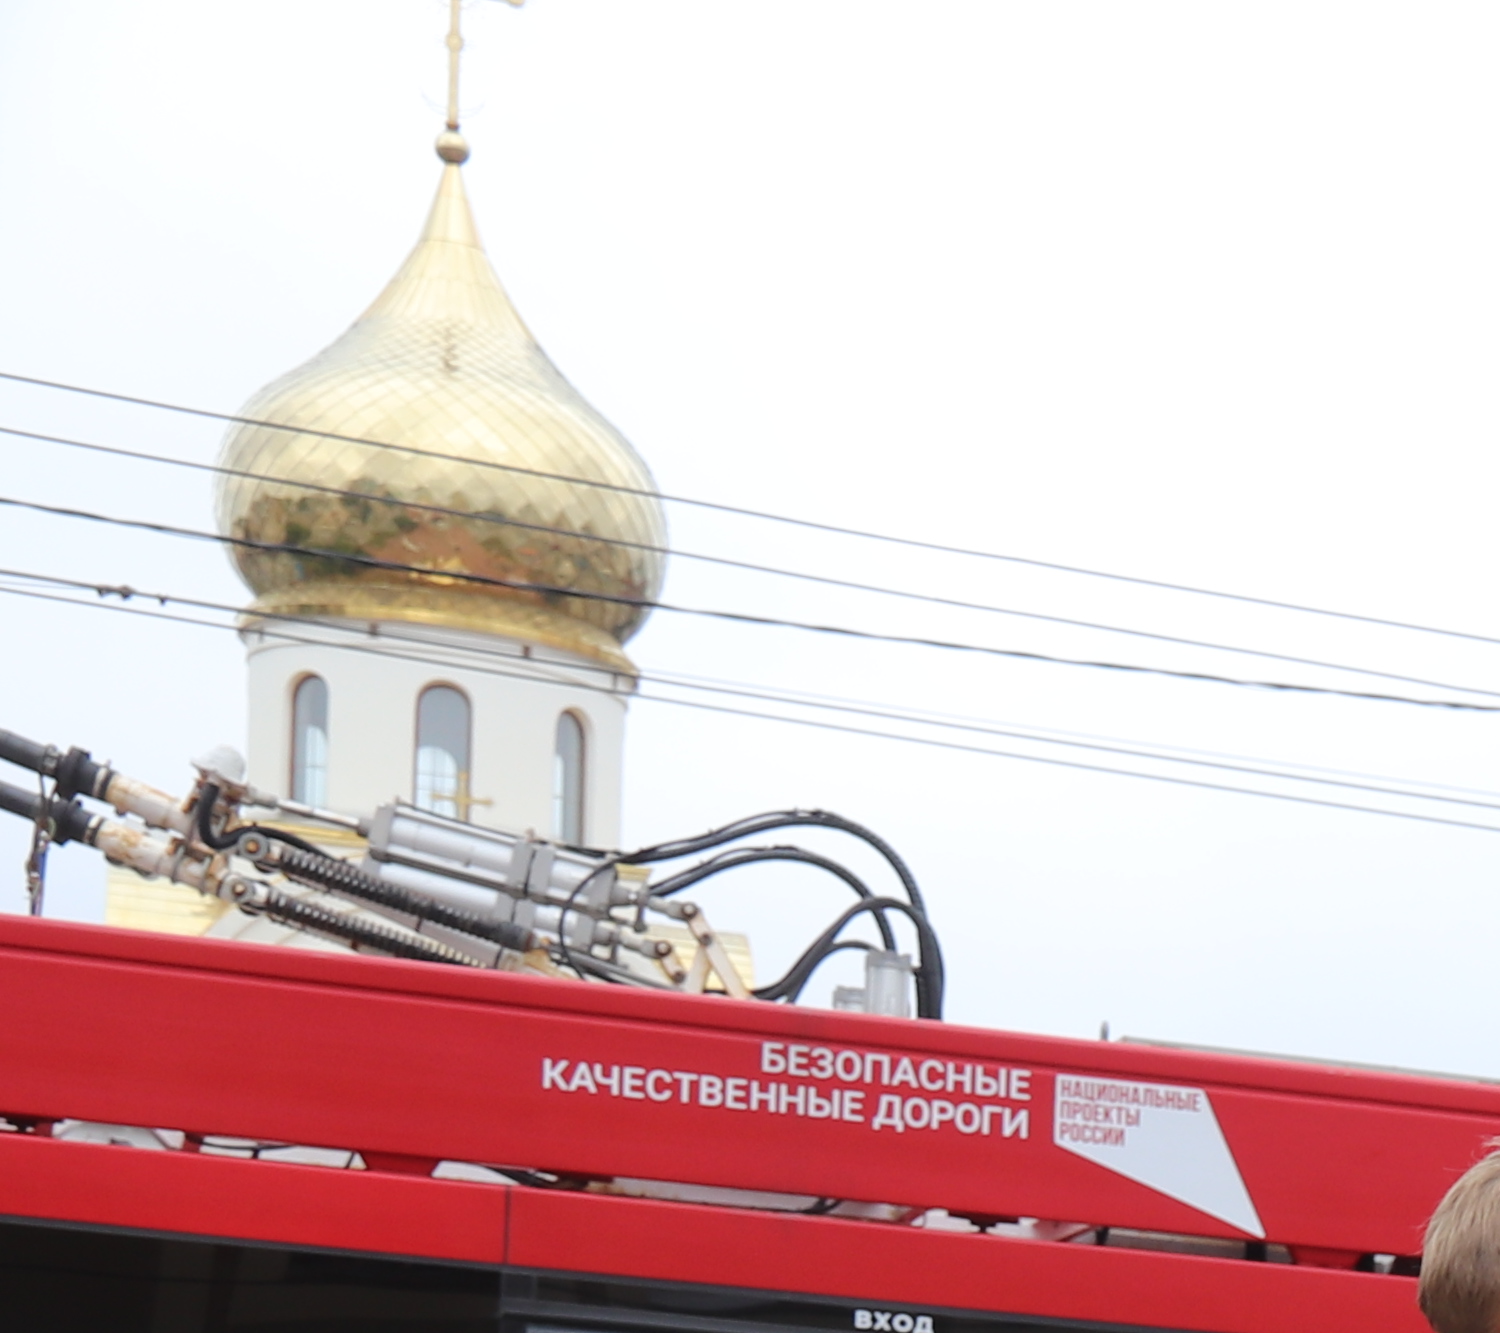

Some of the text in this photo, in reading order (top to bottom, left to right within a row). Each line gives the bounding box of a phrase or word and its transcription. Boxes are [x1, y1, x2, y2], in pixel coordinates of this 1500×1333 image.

[761, 1041, 1032, 1101] БЕЗОПАСНЫЕ
[542, 1057, 1029, 1140] КАЧЕСТВЕННЫЕ ДОРОГИ
[1060, 1079, 1201, 1112] НАЦИОНАЛЬНЫЕ
[1060, 1101, 1140, 1126] ПРОЕКТЫ
[1059, 1122, 1125, 1146] РОССИИ
